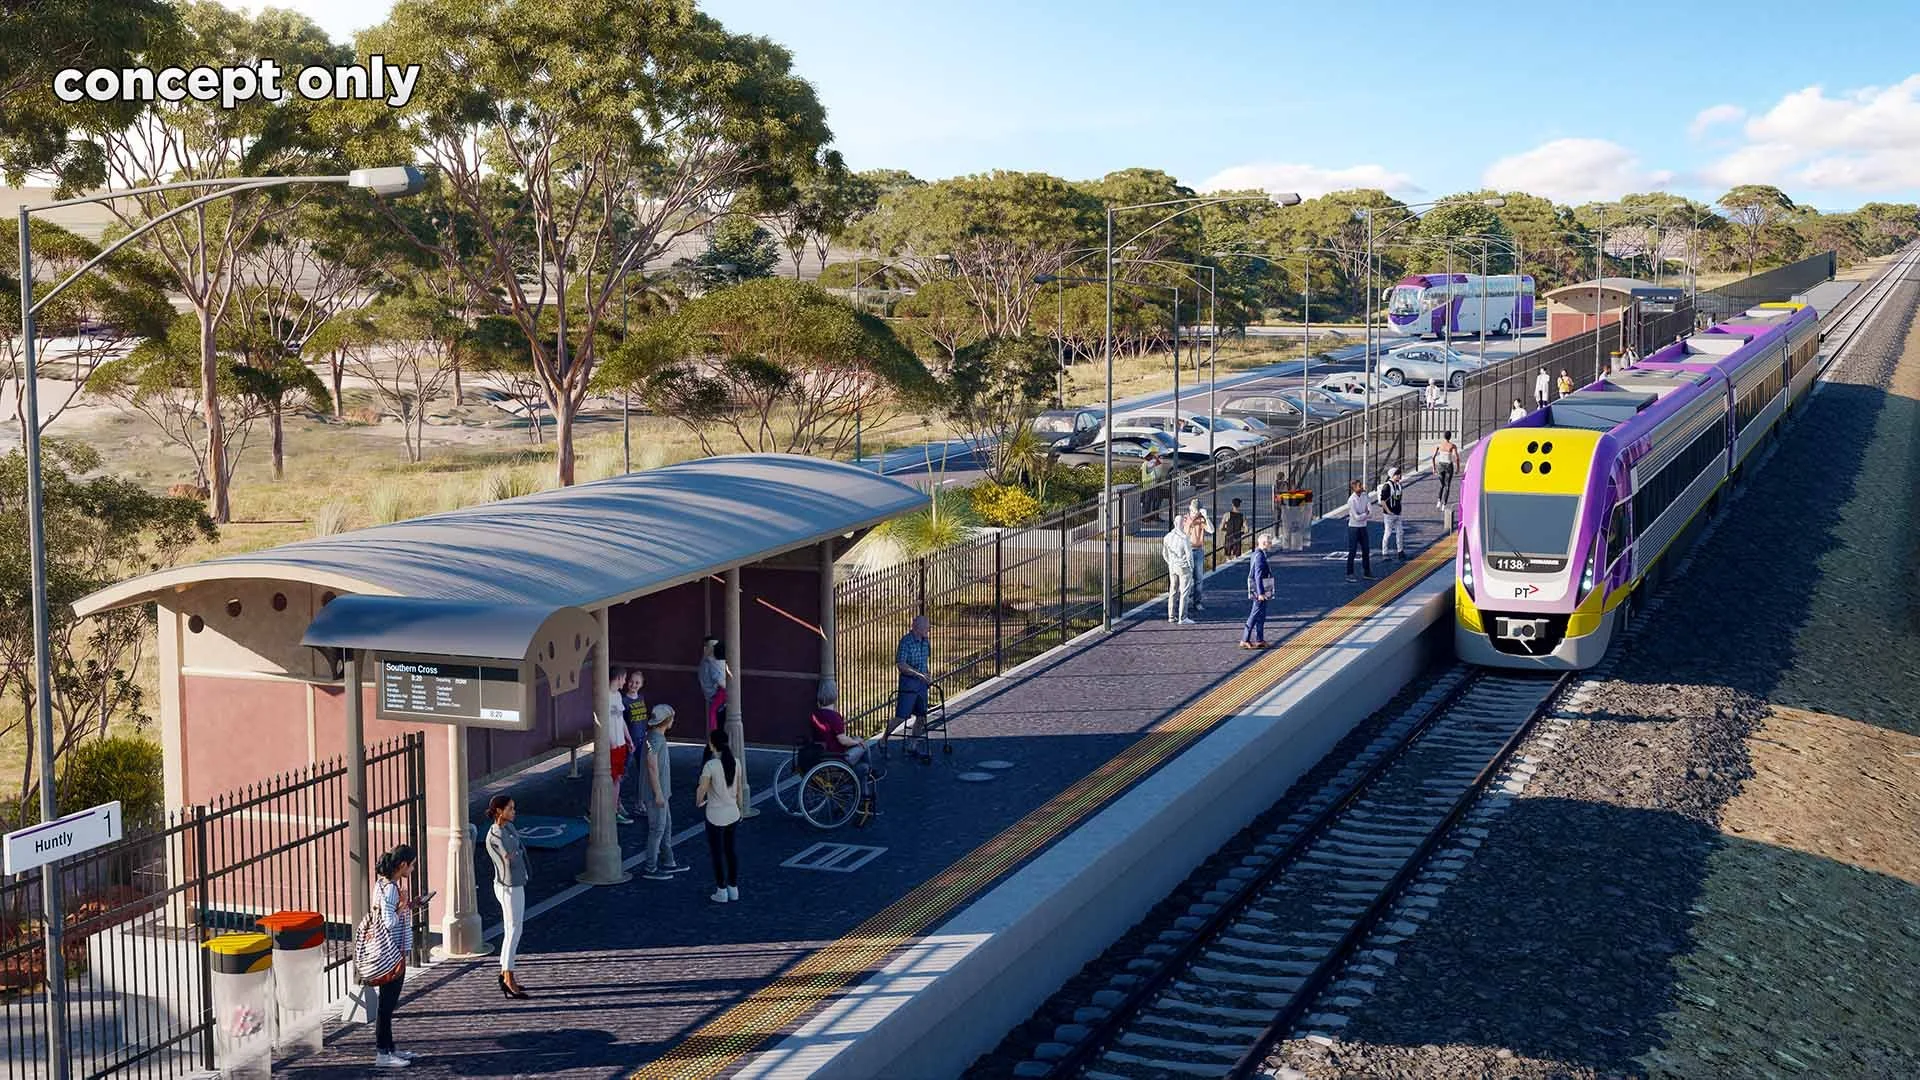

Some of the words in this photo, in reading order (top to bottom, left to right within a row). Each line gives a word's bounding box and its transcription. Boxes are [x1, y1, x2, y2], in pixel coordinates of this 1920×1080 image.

[1514, 587, 1530, 598] PT
[386, 663, 417, 673] Southern
[417, 665, 438, 675] Cross
[35, 831, 73, 853] Huntly
[103, 810, 111, 838] 1
